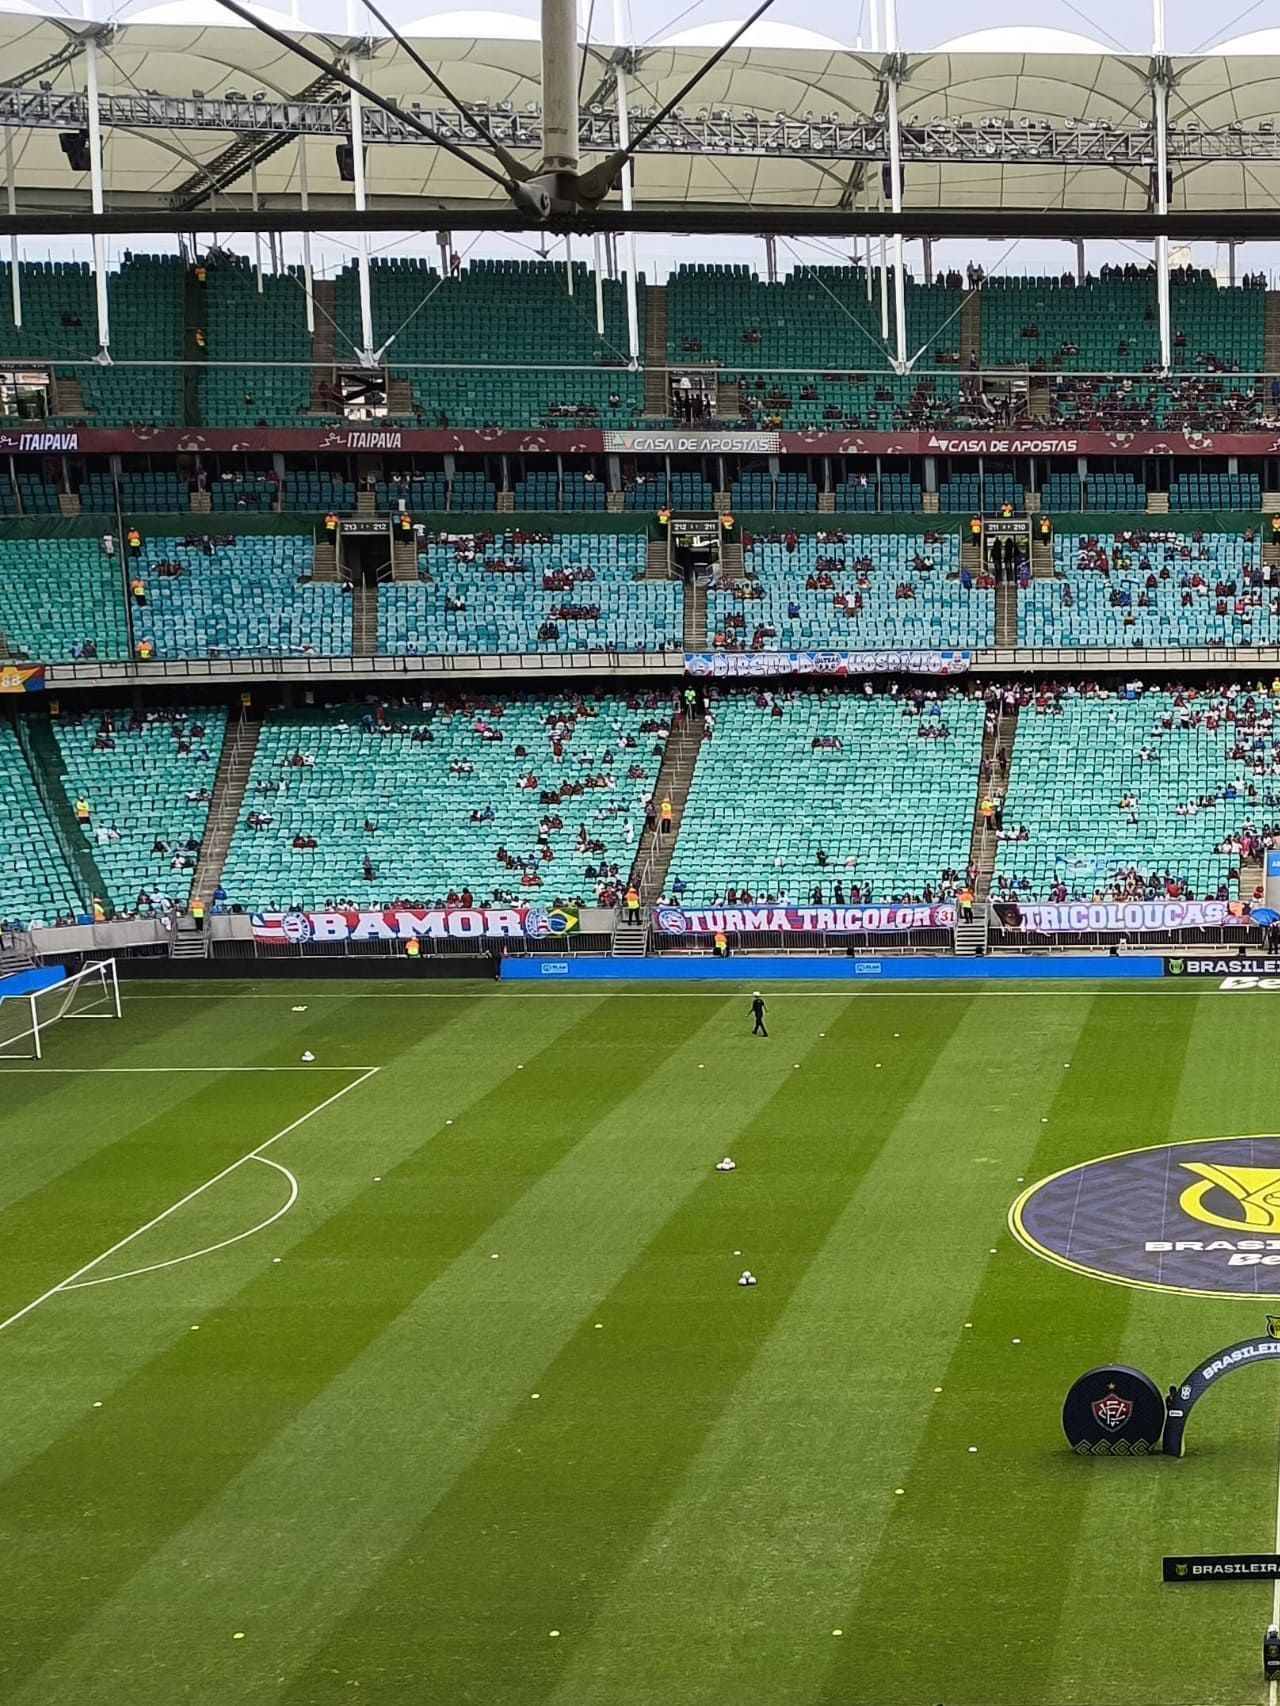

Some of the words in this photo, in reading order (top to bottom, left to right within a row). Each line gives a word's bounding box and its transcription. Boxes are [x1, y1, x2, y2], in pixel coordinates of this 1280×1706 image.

[19, 433, 78, 451] ITAIPAVA
[347, 432, 401, 448] ITAIPAVA
[634, 438, 674, 450] CASA
[678, 438, 697, 450] DE
[700, 438, 769, 450] APOSTAS
[948, 440, 986, 452] CASA
[990, 440, 1009, 452] DE
[1011, 440, 1078, 452] APOSTAS
[309, 910, 524, 940] BAMOR
[684, 909, 791, 932] TURMA
[798, 907, 931, 930] TRICOLOR
[940, 909, 955, 923] 31
[1019, 902, 1225, 930] TRICOLOUCAS
